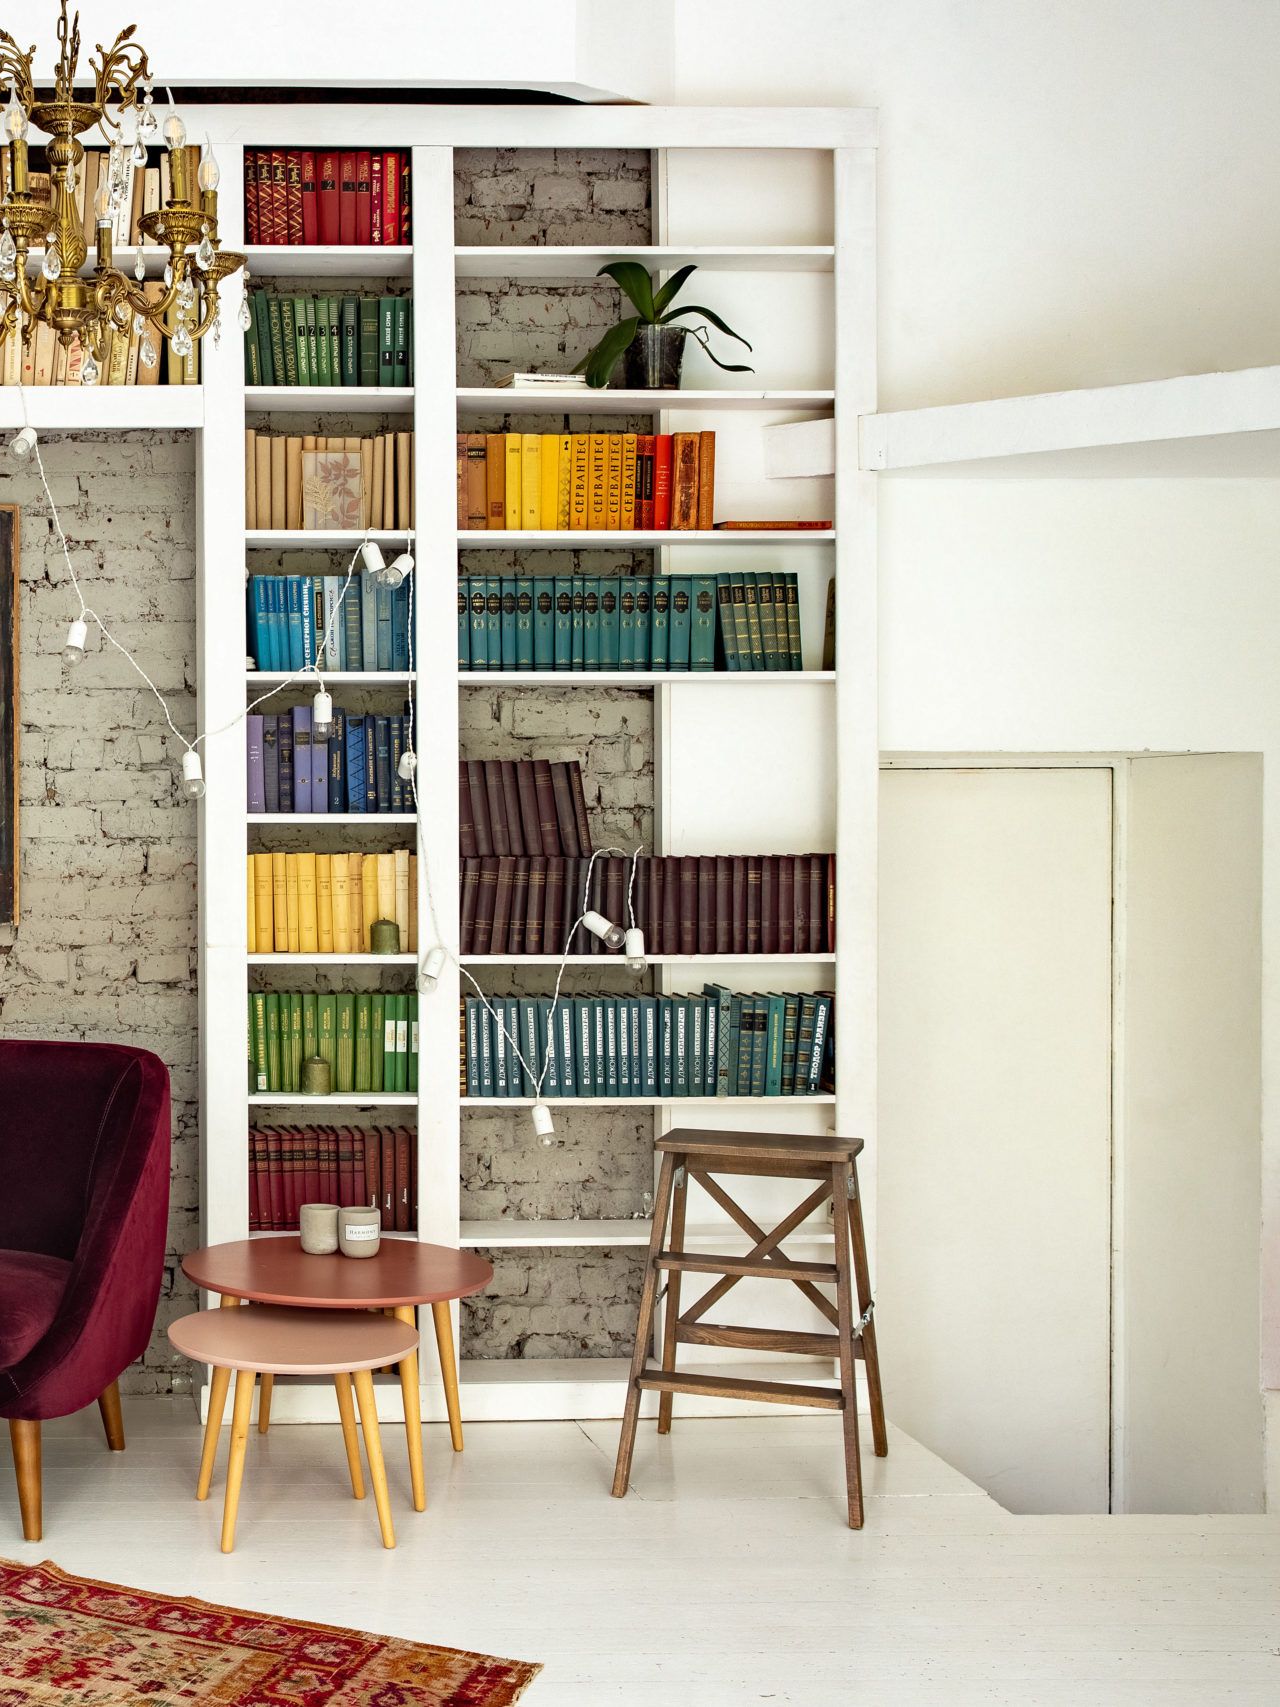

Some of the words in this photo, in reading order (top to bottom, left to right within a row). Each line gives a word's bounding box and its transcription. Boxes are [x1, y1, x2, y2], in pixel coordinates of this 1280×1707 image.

[270, 302, 280, 342] ЛУКОНИН
[283, 302, 293, 342] ЛУКОНИН
[274, 344, 284, 381] МИХАИЛ
[286, 344, 296, 381] МИХАИЛ
[575, 439, 587, 513] СЕРВАНТЕС
[593, 439, 604, 513] СЕРВАНТЕС
[609, 439, 620, 513] СЕРВАНТЕС
[624, 439, 635, 513] СЕРВАНТЕС
[813, 1004, 827, 1045] ДРАЙЗЕР
[564, 1058, 572, 1079] ДЖОН
[646, 1056, 654, 1078] ДЖОН
[707, 1055, 715, 1077] ДЖОН
[809, 1045, 821, 1079] ТЕОДОР
